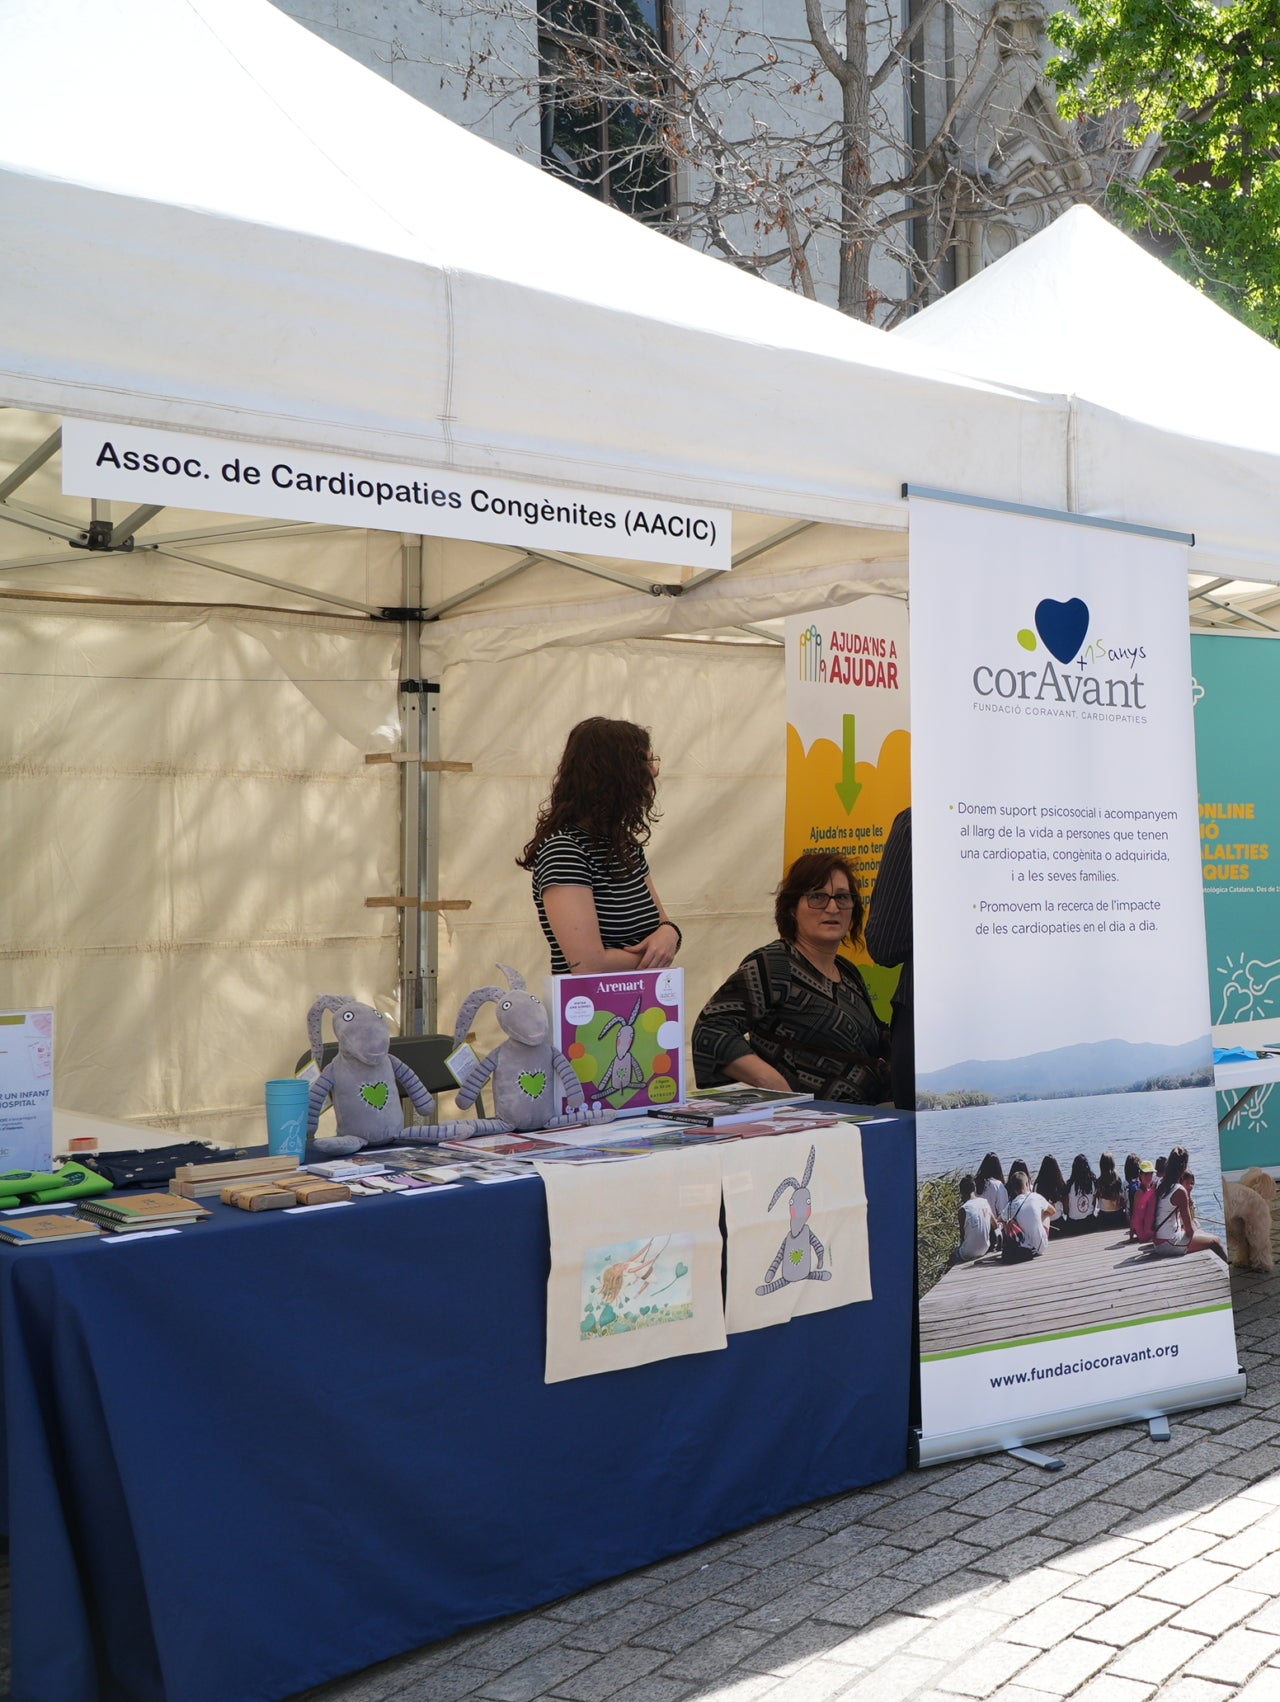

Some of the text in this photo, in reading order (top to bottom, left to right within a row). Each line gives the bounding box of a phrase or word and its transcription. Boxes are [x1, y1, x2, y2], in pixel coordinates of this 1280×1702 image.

[96, 442, 717, 547] Assoc. de Cardiopaties Congènites (AACIC)
[830, 631, 898, 659] AJUDA'NS A
[1108, 646, 1147, 669] anys
[829, 655, 899, 690] AJUDAR
[973, 661, 1147, 710] corAvant
[973, 702, 1022, 715] FUNDACIÓ
[1081, 711, 1148, 725] CARDIOPATIES
[958, 802, 1178, 822] Donem suport psicosocial i acompanyem
[848, 828, 854, 838] a
[855, 827, 870, 840] que
[872, 824, 883, 837] les
[960, 825, 1169, 842] al llarg de la vida a persones que tenen
[857, 844, 869, 855] no
[960, 848, 1170, 863] una cardiopatia, congènita o adquirida,
[1011, 870, 1015, 882] i
[1017, 872, 1025, 882] a
[1028, 869, 1044, 882] les
[1047, 872, 1077, 882] seves
[980, 899, 1161, 913] Promovem la recerca de l'impacte
[975, 919, 1158, 936] de les cardiopaties en el dia a dia.
[596, 979, 645, 994] Arenart
[20, 1089, 50, 1099] INFANT
[990, 1344, 1179, 1388] www.fundaciocoravant.org
